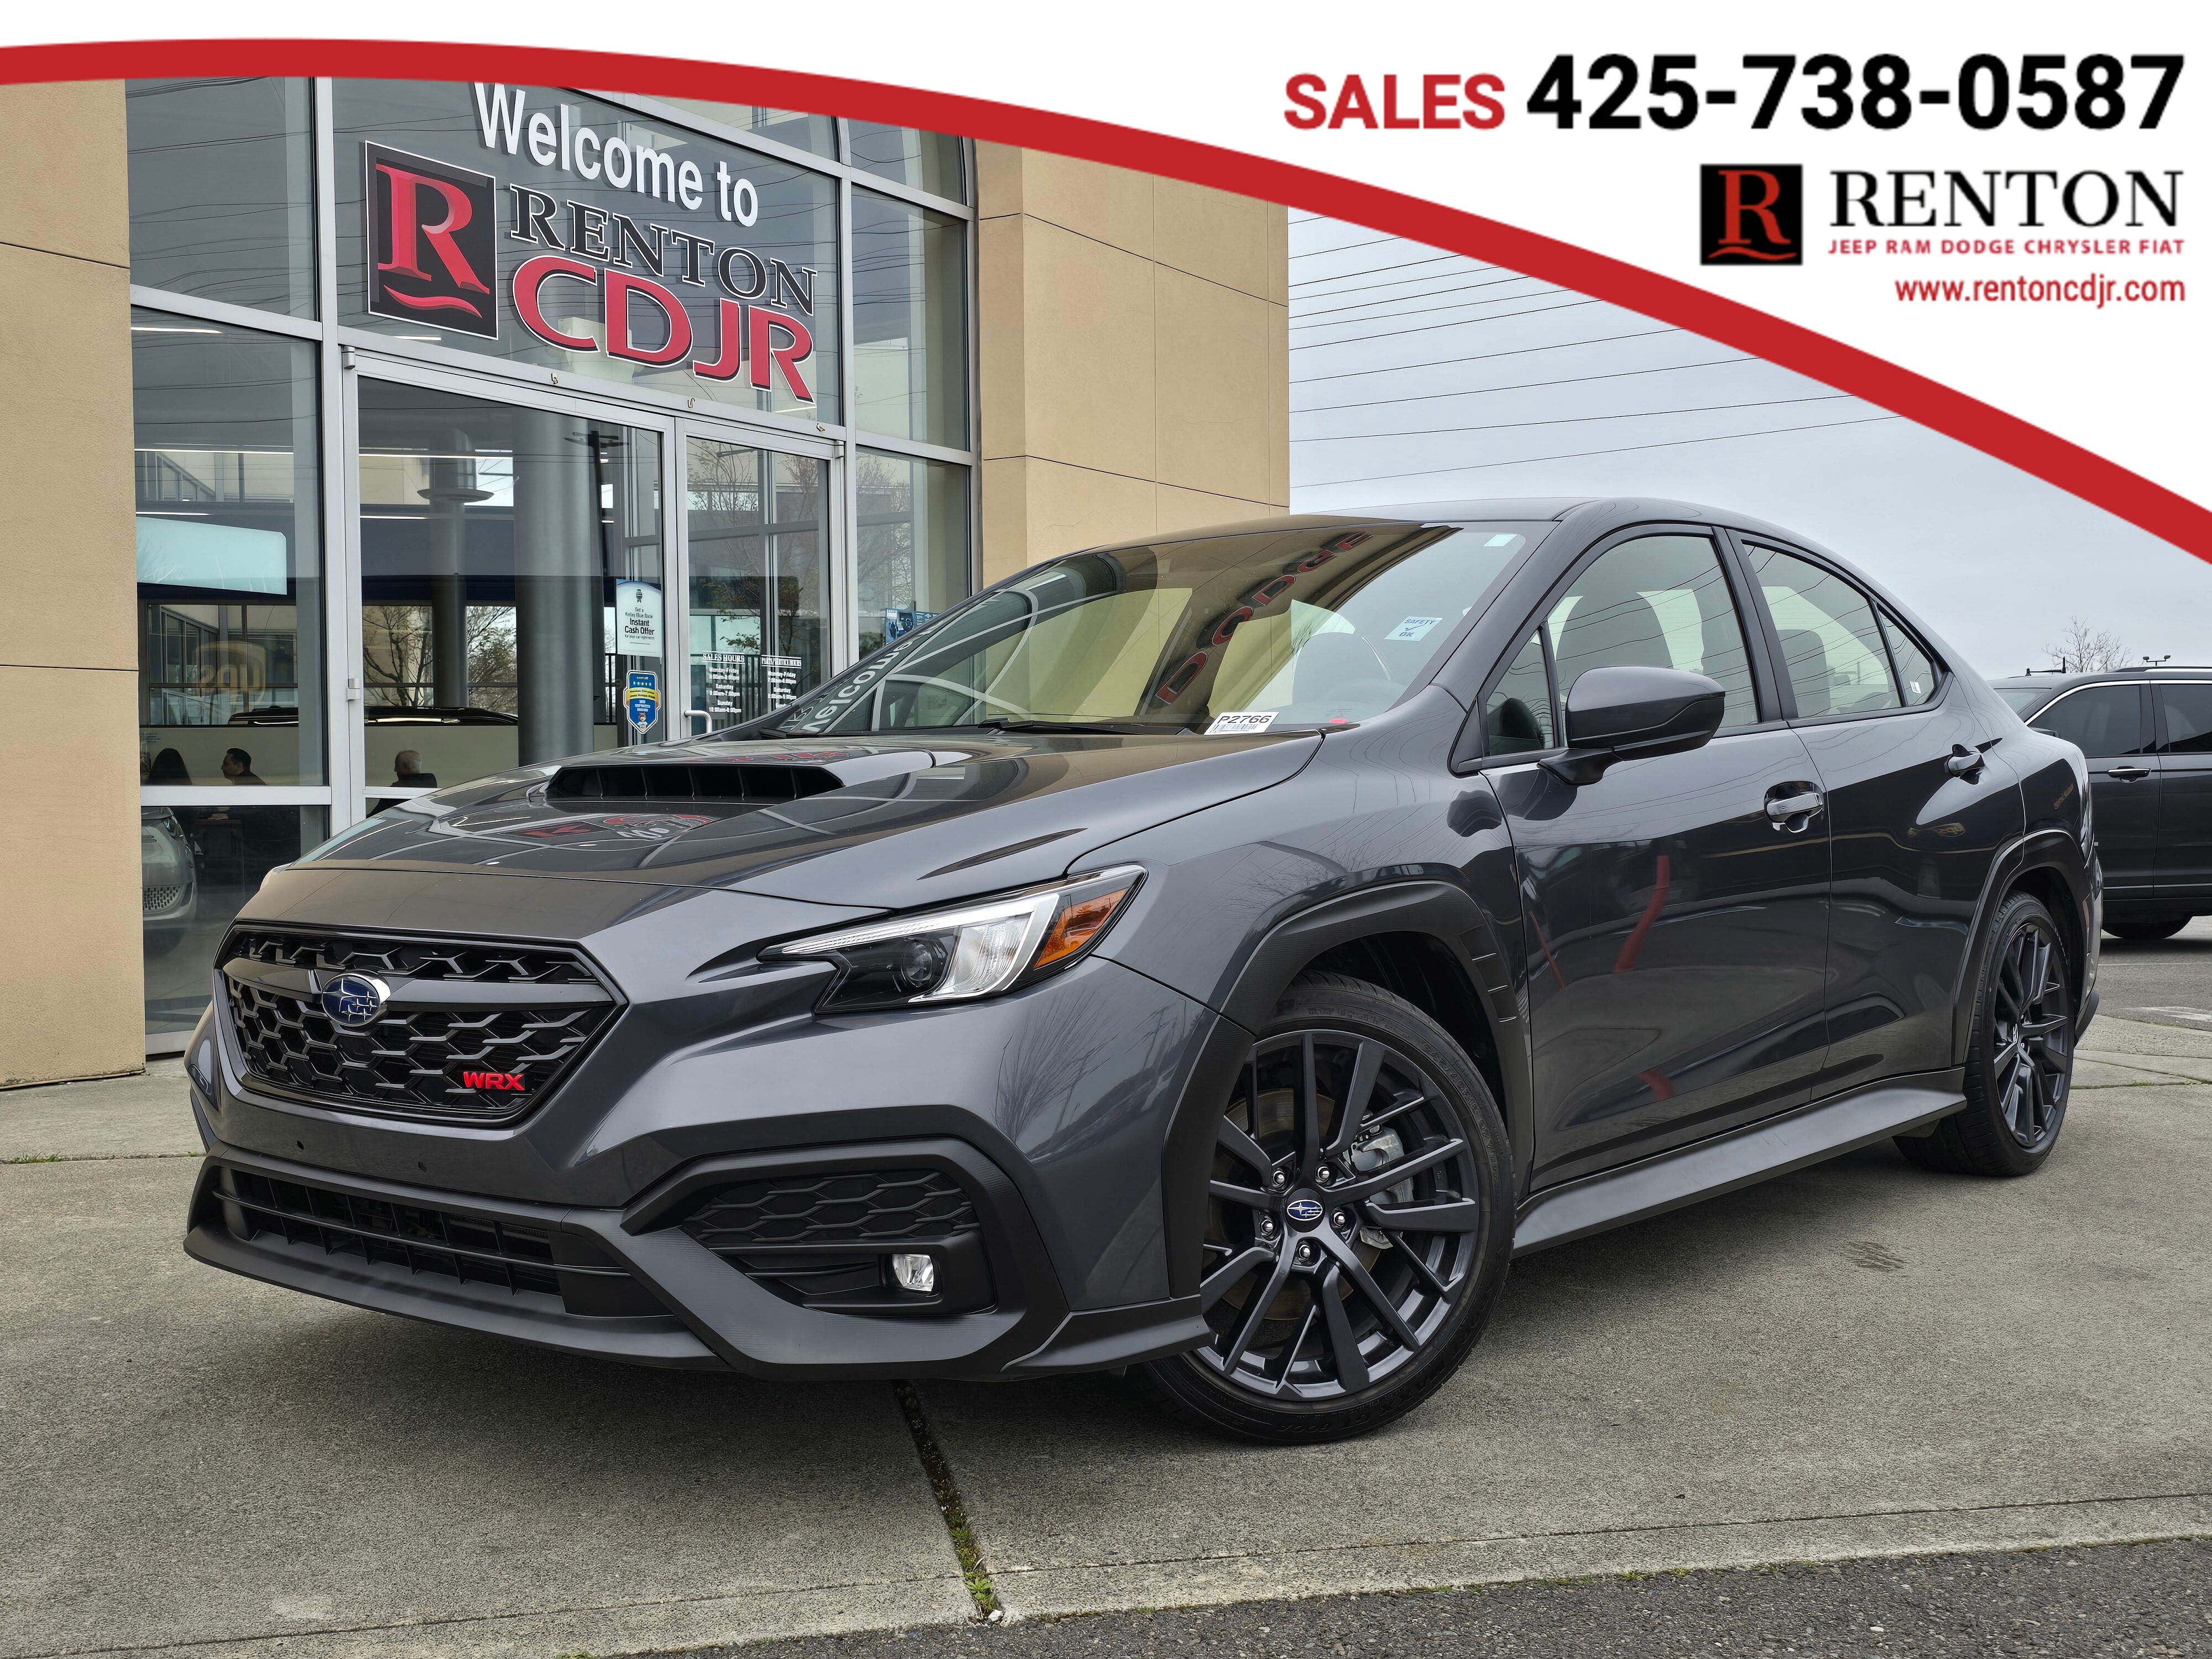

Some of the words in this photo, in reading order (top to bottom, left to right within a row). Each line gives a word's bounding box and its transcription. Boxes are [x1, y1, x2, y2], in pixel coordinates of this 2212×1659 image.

[474, 82, 703, 211] Welcome
[717, 160, 758, 227] to
[509, 183, 818, 316] RENTON
[512, 255, 816, 404] CDJR
[629, 618, 650, 627] Instant
[624, 625, 639, 634] Cash
[640, 627, 655, 635] Offer
[703, 653, 722, 661] SALES
[723, 654, 745, 662] HOURS
[1217, 716, 1272, 724] P2766
[463, 1072, 525, 1091] WRX
